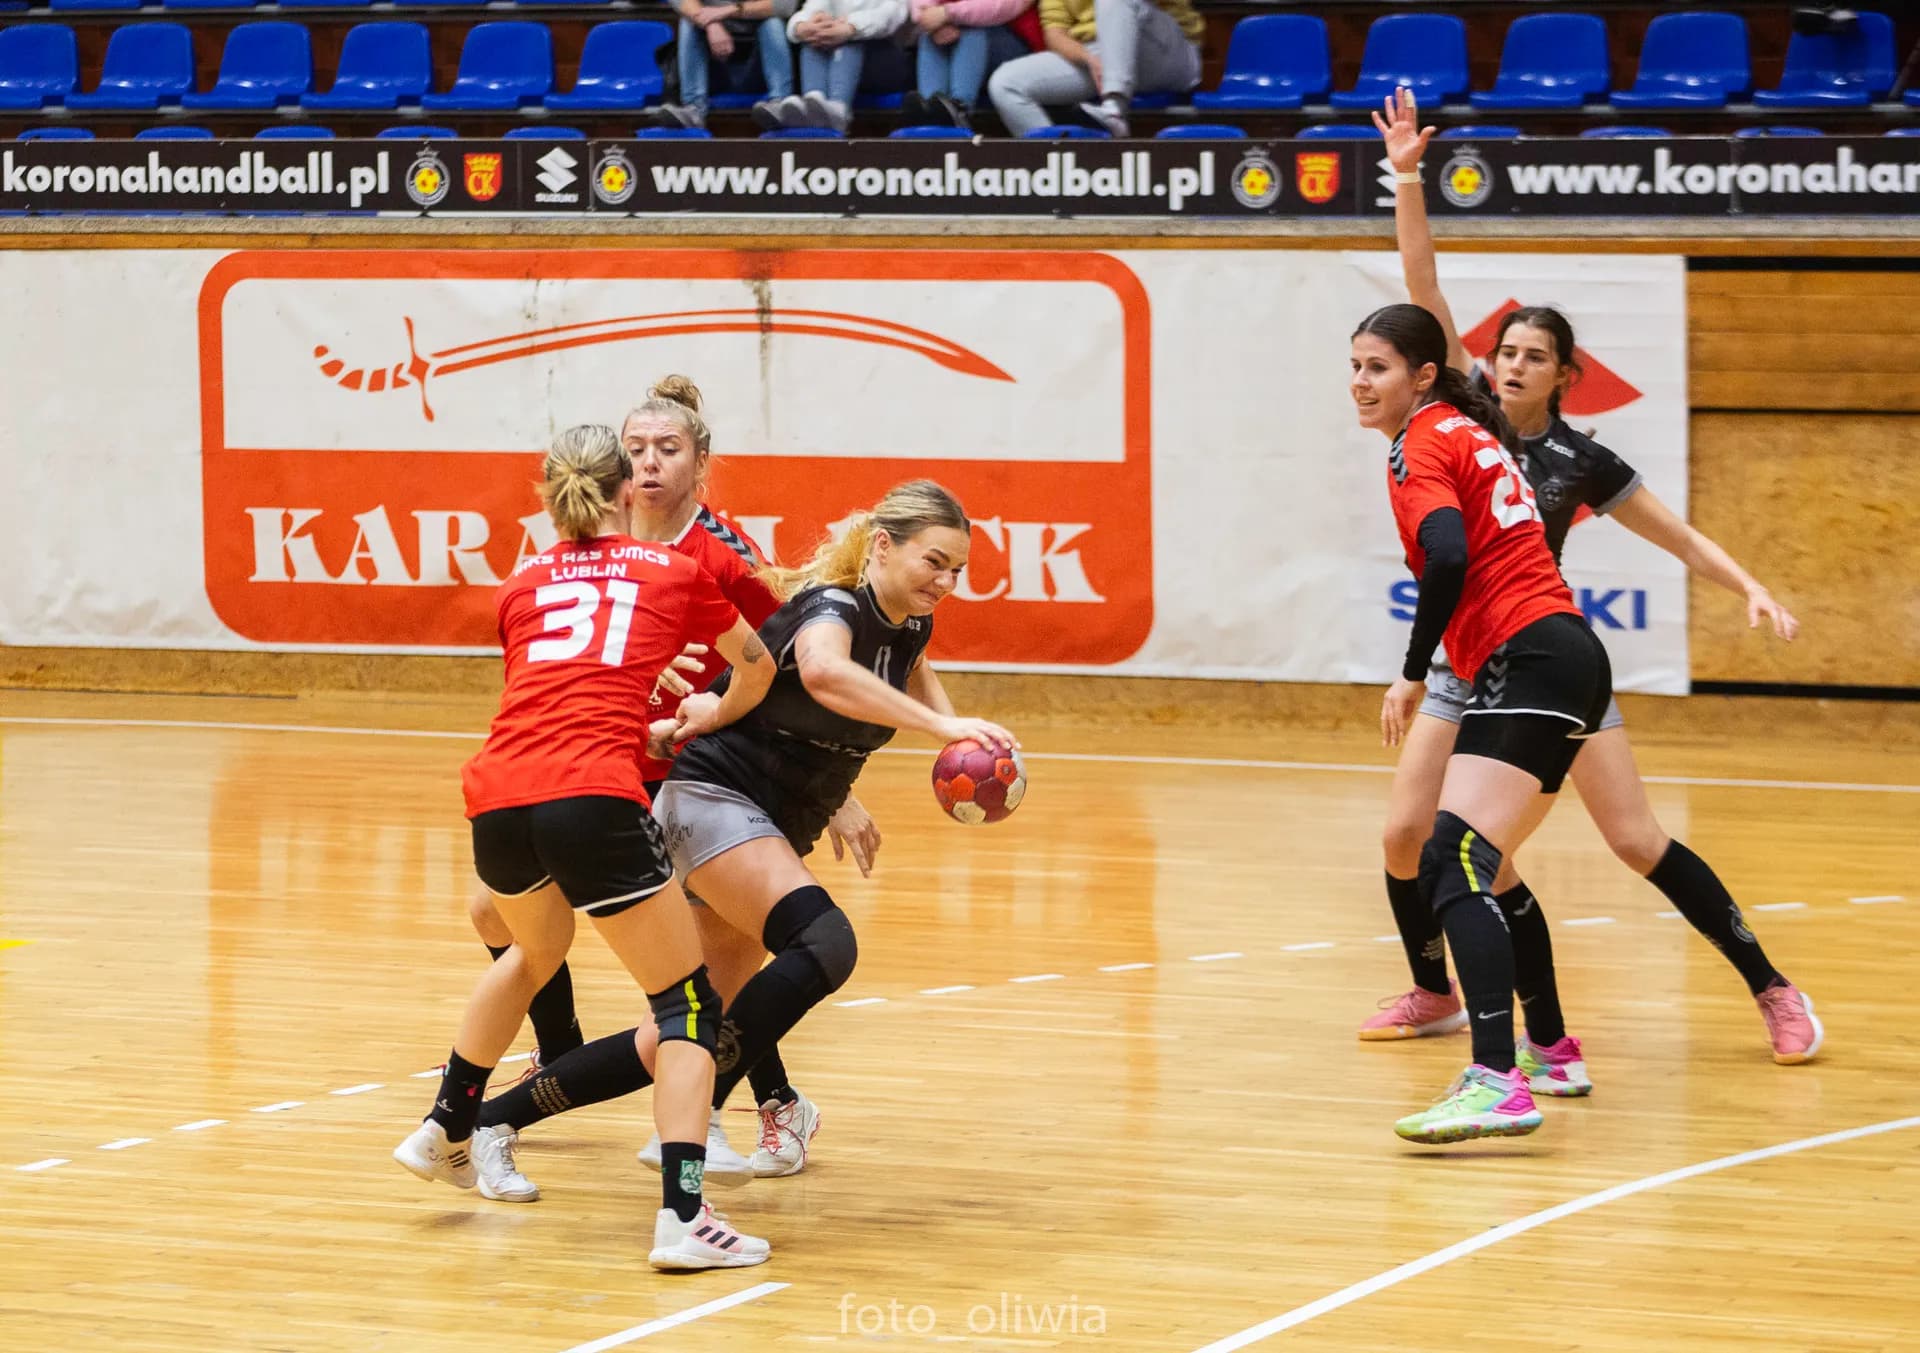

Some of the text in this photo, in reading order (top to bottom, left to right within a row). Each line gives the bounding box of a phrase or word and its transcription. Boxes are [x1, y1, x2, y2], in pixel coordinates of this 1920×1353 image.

[3, 151, 390, 207] koronahandball.pl
[651, 151, 1215, 210] www.koronahandball.pl
[551, 564, 627, 581] LUBLIN
[610, 546, 670, 567] UMCS
[527, 578, 640, 667] 31
